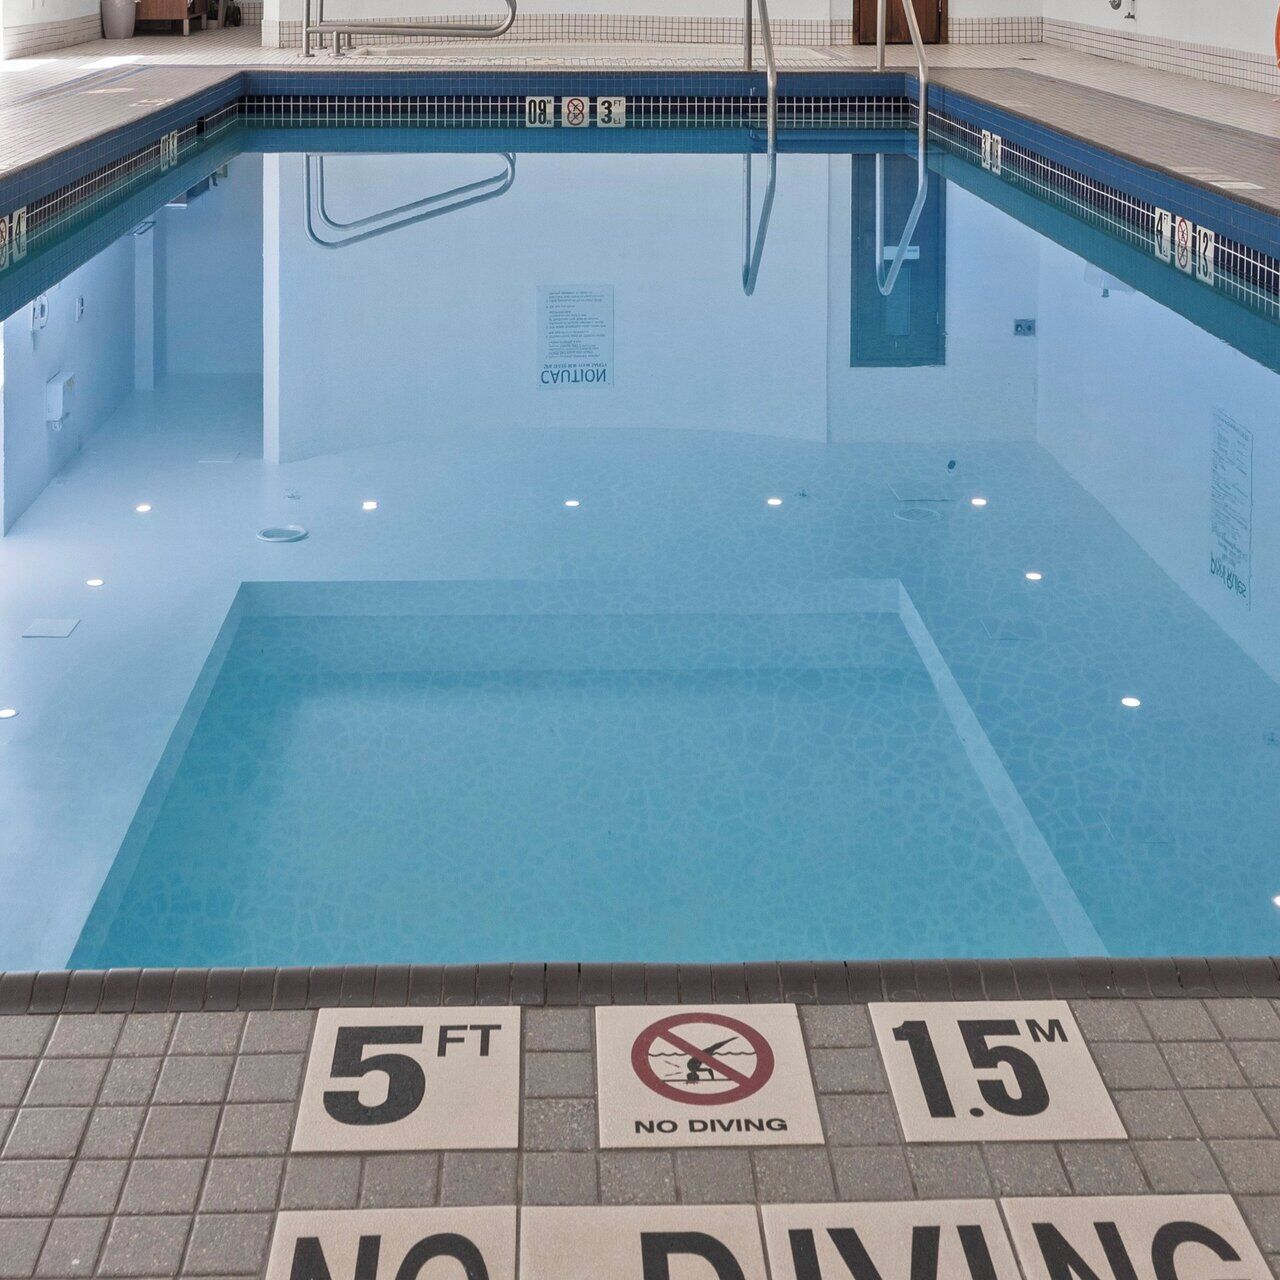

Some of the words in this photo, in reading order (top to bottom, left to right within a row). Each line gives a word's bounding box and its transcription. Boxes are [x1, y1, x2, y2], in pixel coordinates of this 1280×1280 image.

[323, 1025, 426, 1126] 5
[437, 1024, 502, 1057] FT
[892, 1019, 1050, 1117] 1.5
[1025, 1019, 1069, 1043] M
[634, 1120, 678, 1133] NO
[688, 1118, 788, 1133] DIVING
